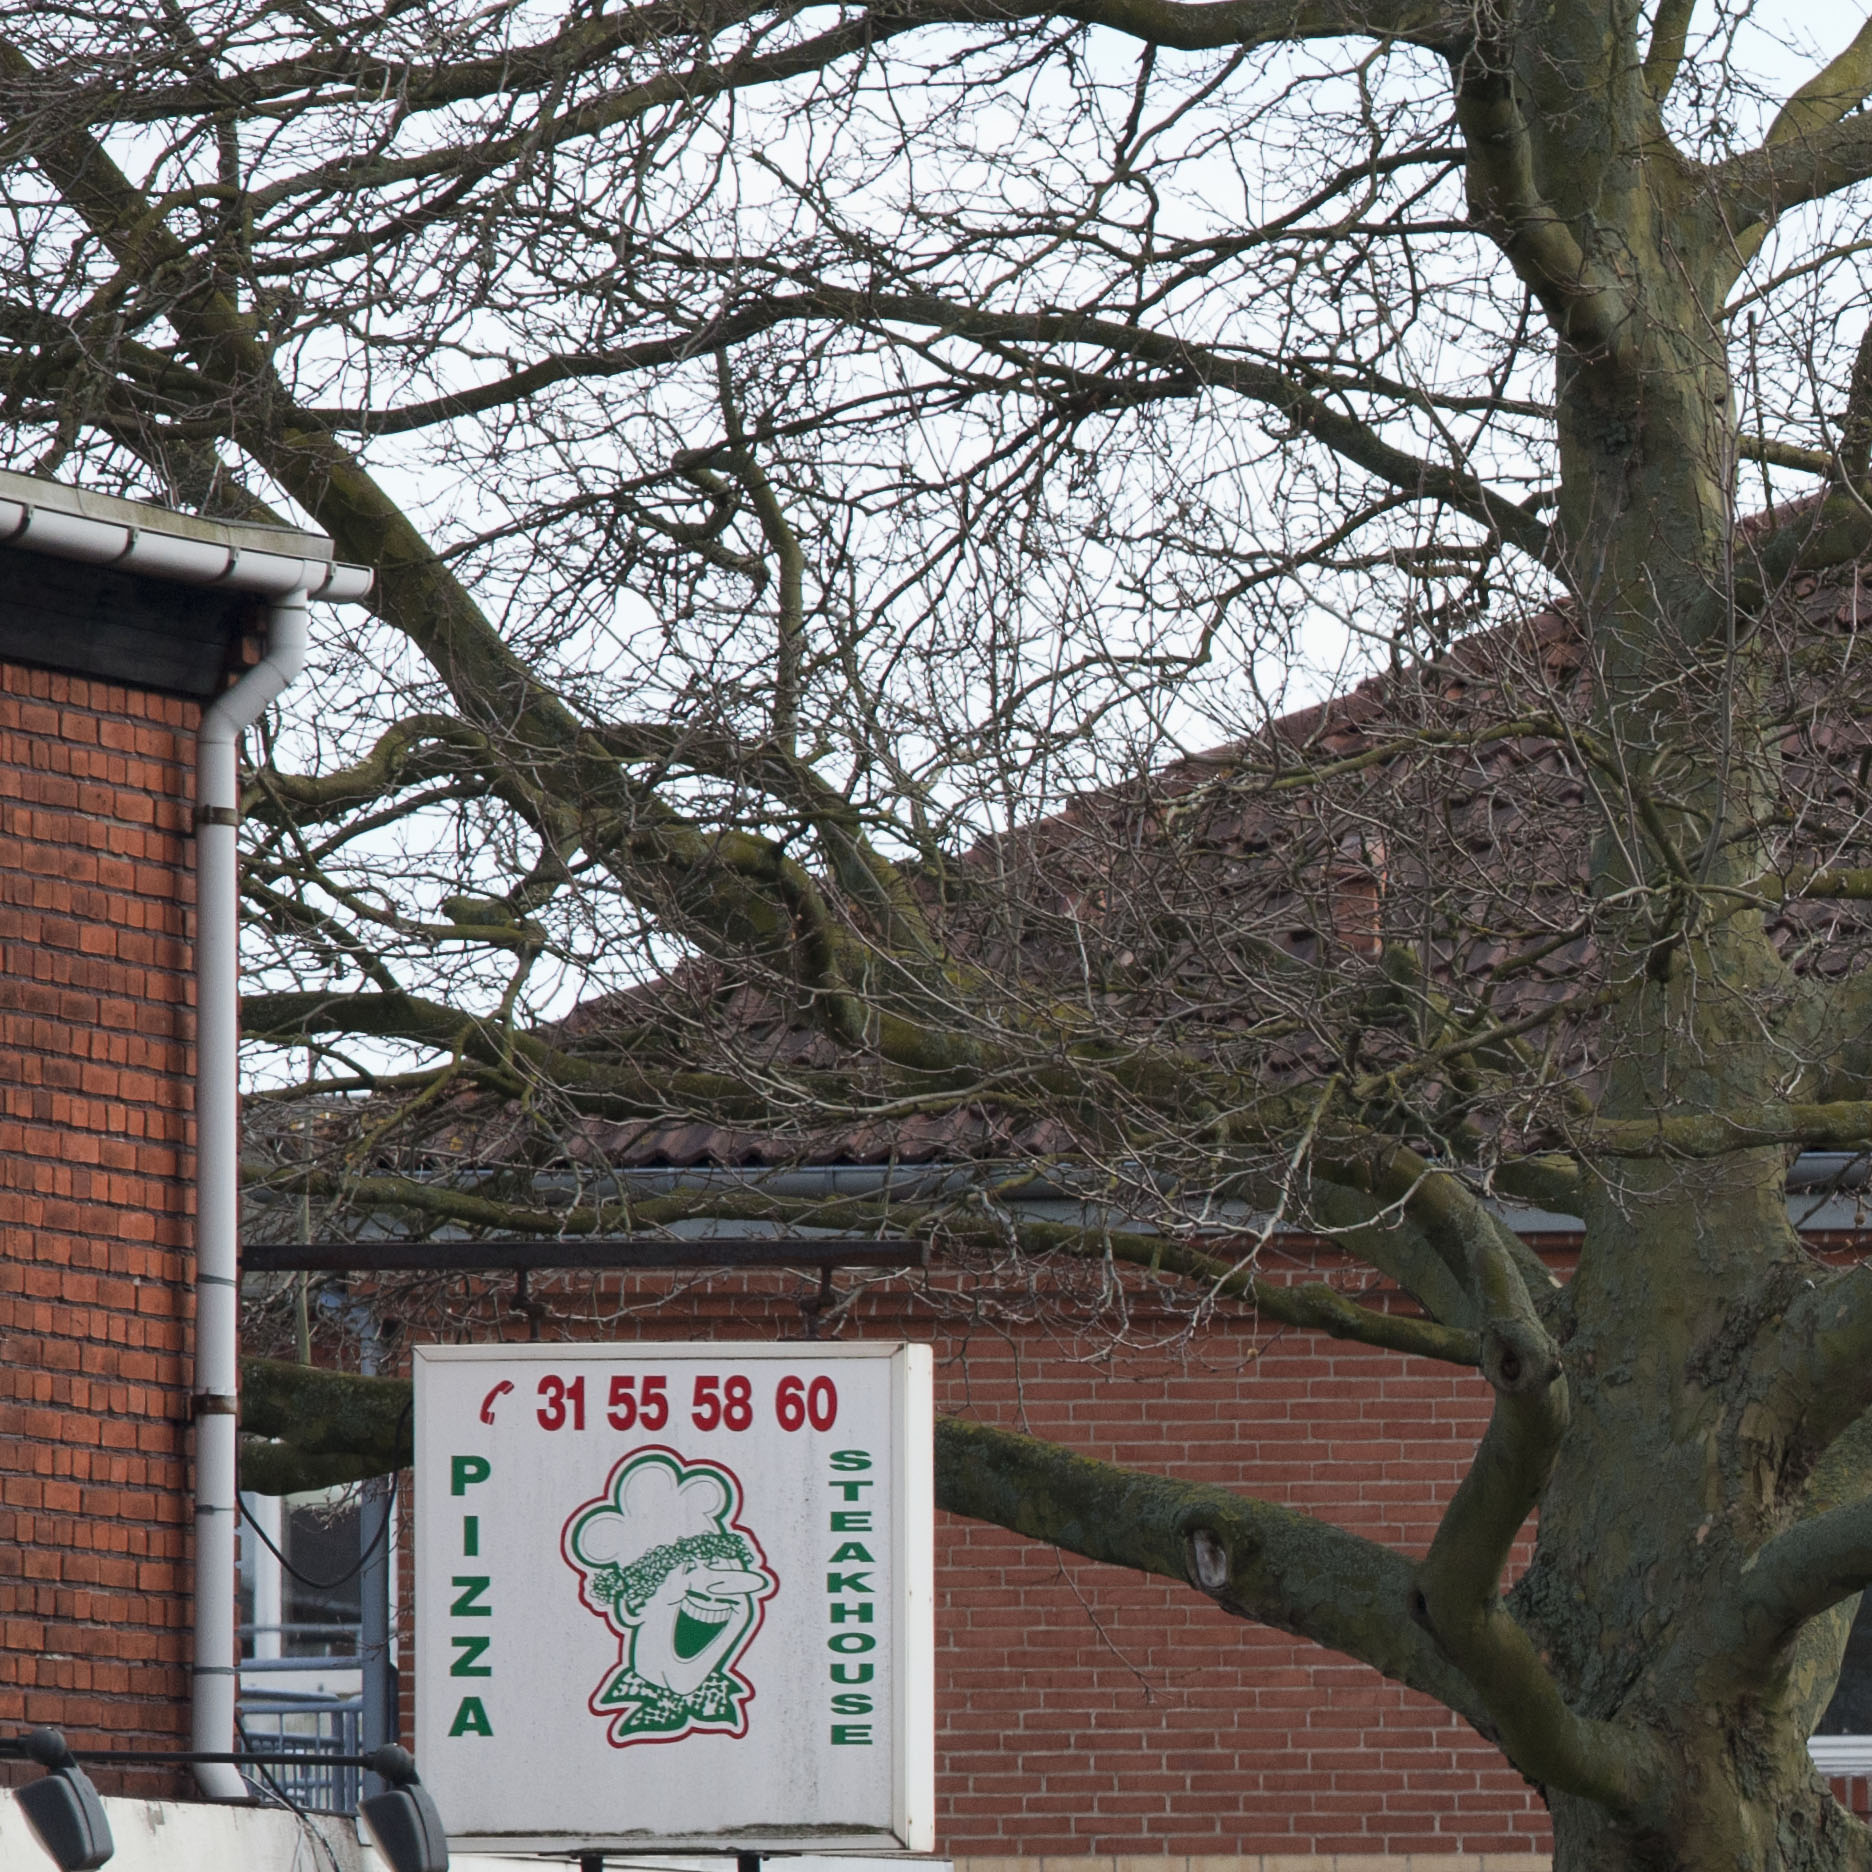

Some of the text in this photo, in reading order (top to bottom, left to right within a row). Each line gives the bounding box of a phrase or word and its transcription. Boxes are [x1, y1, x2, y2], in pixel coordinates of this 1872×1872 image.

[536, 1375, 838, 1432] 31 55 58 60
[448, 1454, 494, 1738] PIZZA
[826, 1449, 874, 1745] STEAKHOUSE
